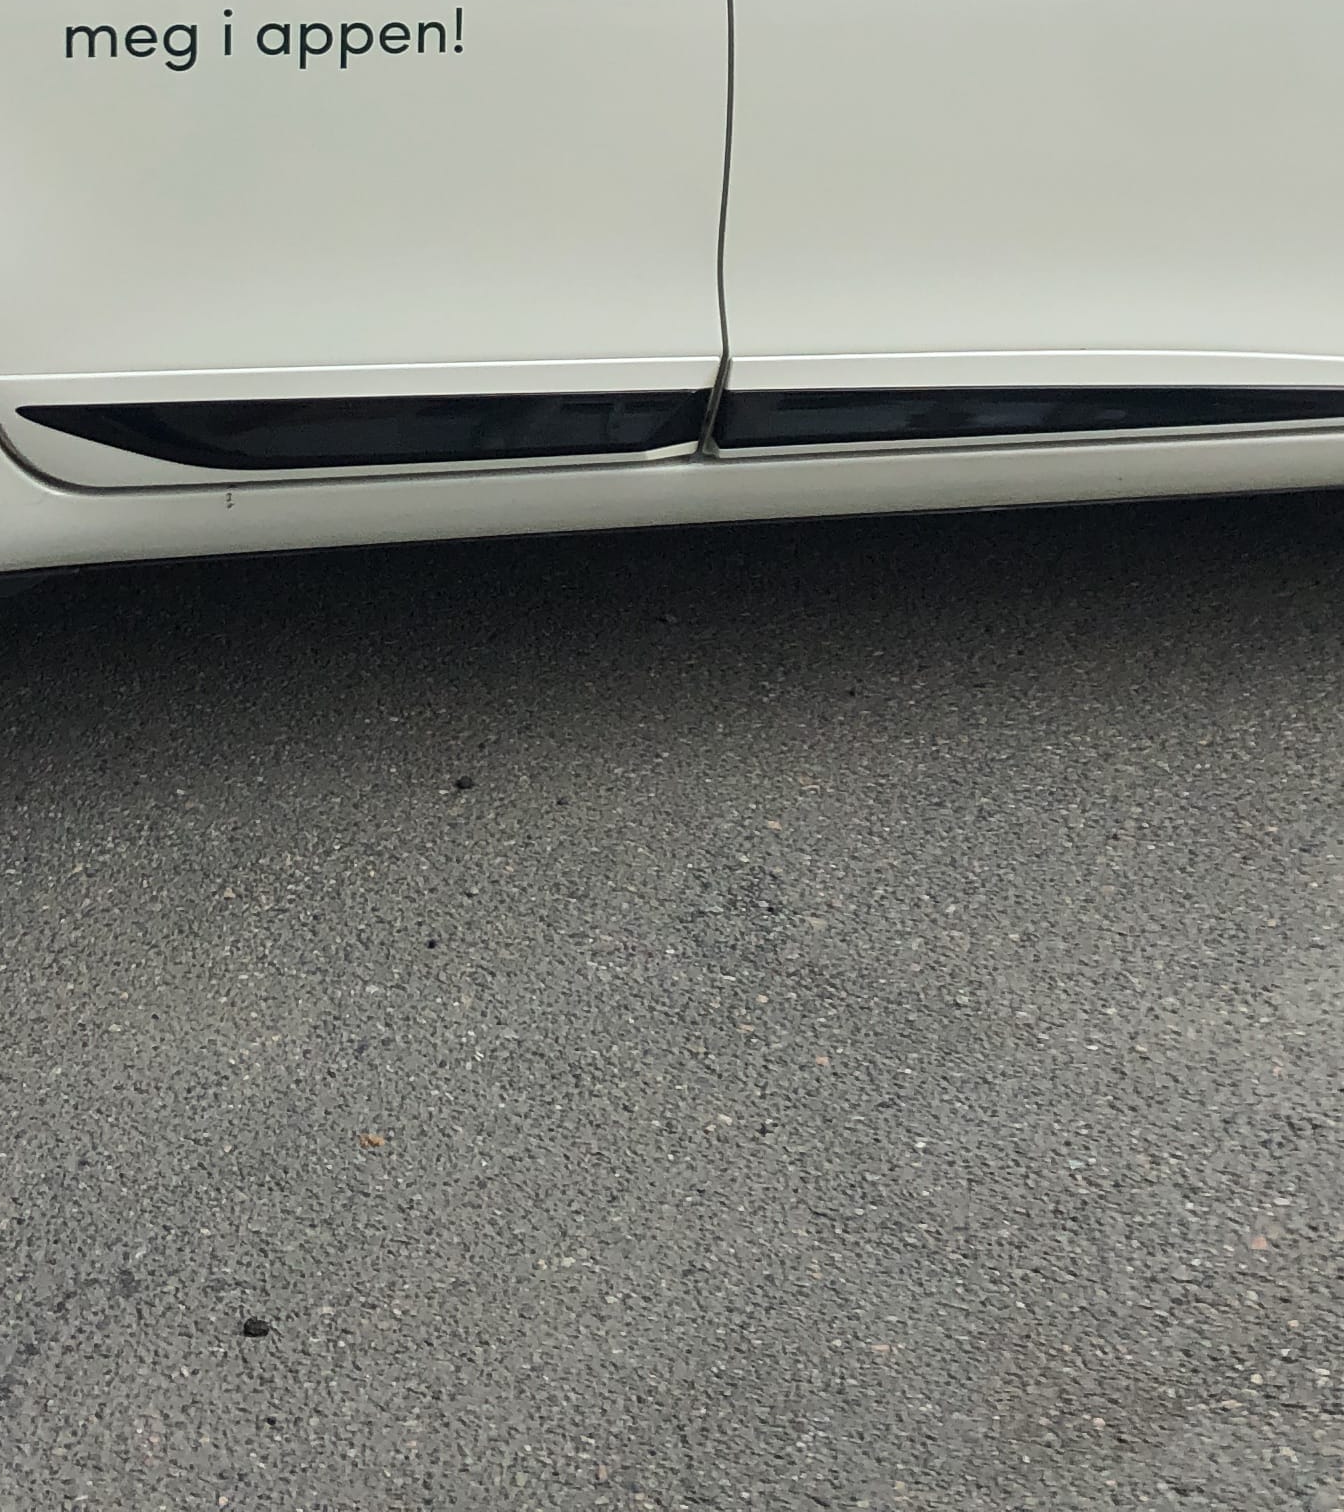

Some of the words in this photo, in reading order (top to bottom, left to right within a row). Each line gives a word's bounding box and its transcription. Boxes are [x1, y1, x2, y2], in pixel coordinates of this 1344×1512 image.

[65, 22, 199, 72] meg
[222, 8, 234, 57] i
[255, 7, 465, 70] appen!
